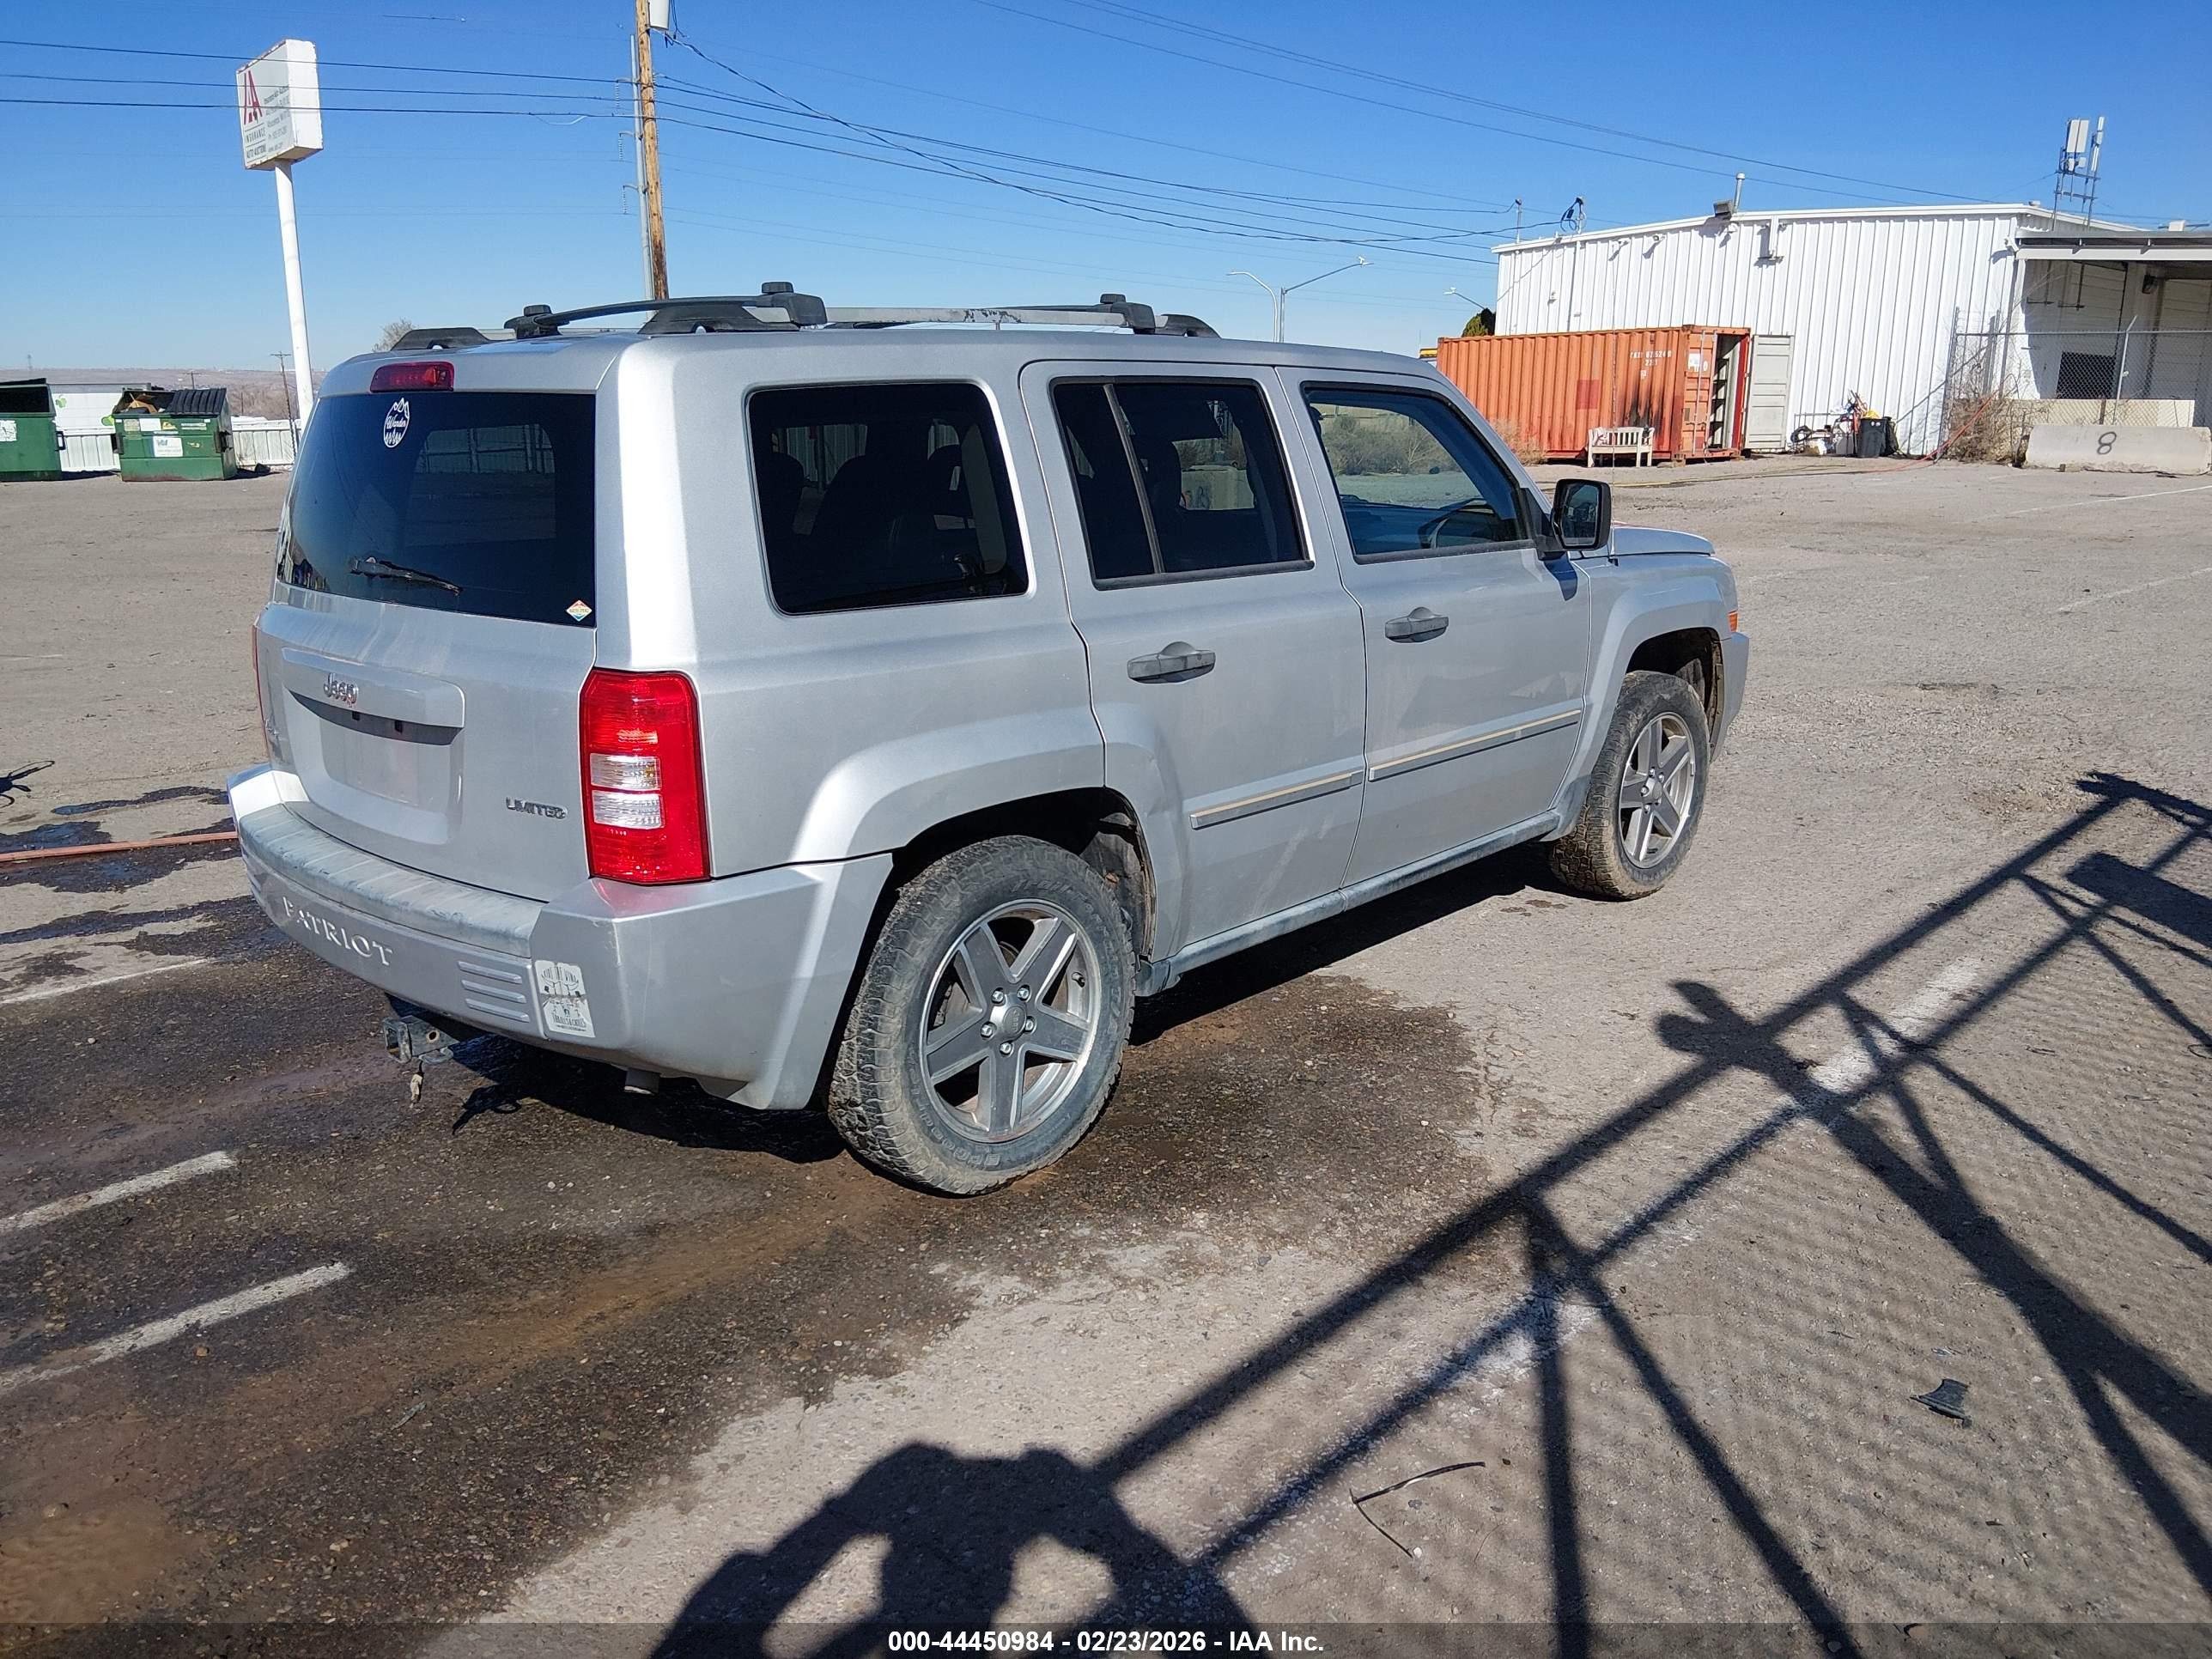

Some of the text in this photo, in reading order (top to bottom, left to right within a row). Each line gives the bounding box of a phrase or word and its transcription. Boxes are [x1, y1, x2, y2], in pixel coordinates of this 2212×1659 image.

[2097, 431, 2117, 455] 8
[323, 672, 359, 708] Jeep
[505, 796, 568, 820] LIMITED
[283, 896, 393, 967] PATRIOT
